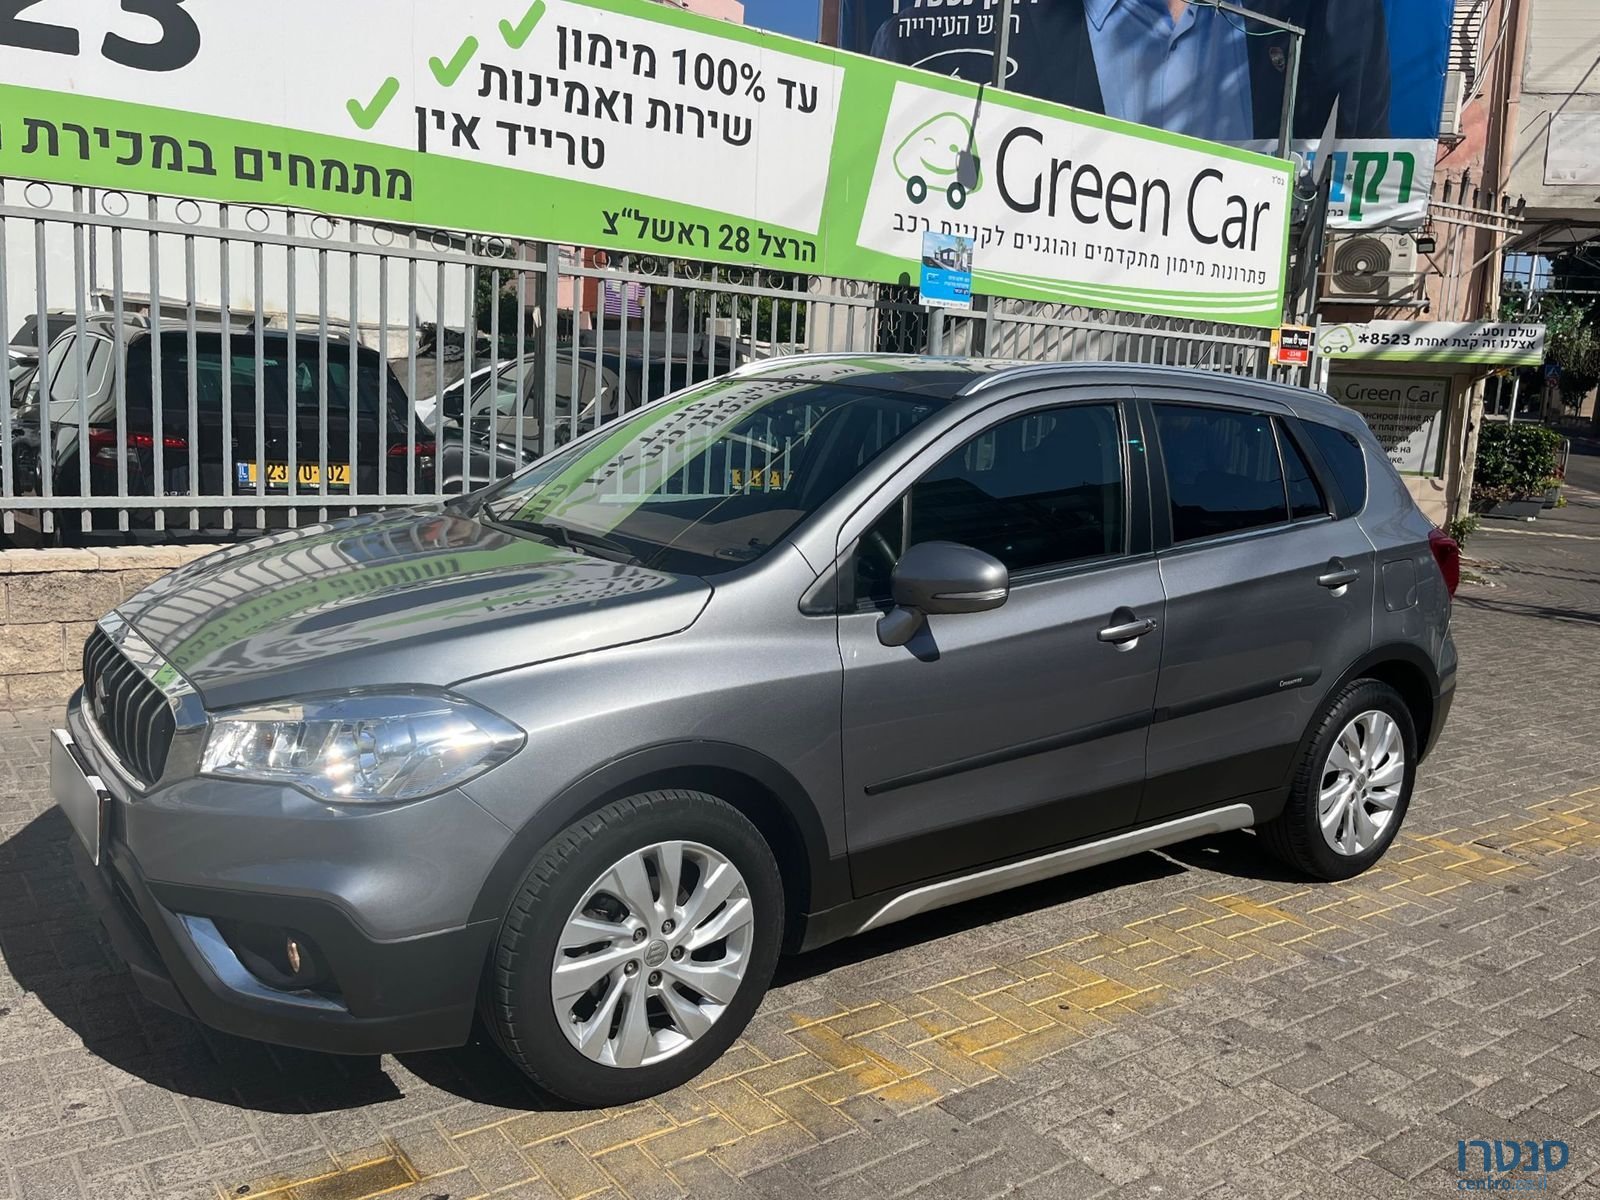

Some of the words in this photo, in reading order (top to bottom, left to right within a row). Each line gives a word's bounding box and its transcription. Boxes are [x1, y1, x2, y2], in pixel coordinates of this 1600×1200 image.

[899, 15, 969, 38] העירייה
[977, 14, 1020, 35] רש
[556, 25, 656, 79] מימון
[672, 49, 766, 103] 100%
[478, 62, 633, 125] ואמינות
[777, 77, 818, 114] עד
[414, 106, 481, 153] אין
[645, 97, 752, 147] שירות
[22, 117, 217, 176] במכירת
[496, 119, 605, 169] טרייד
[235, 146, 412, 201] מתמחים
[996, 126, 1171, 236] Green
[1187, 168, 1271, 252] Car
[893, 212, 930, 233] רכב
[719, 224, 750, 253] 28
[758, 228, 816, 264] הרצל
[1013, 232, 1077, 258] והוגנים
[1085, 243, 1159, 270] מתקדמים
[1166, 255, 1205, 275] מימון
[1211, 263, 1266, 285] פתרונות
[1414, 337, 1449, 348] אחרת
[1451, 338, 1479, 350] קצת
[1482, 338, 1497, 348] זה
[1500, 338, 1535, 350] אצלנו
[1509, 327, 1537, 338] שלם
[1345, 384, 1401, 401] Green
[1406, 385, 1440, 403] Car
